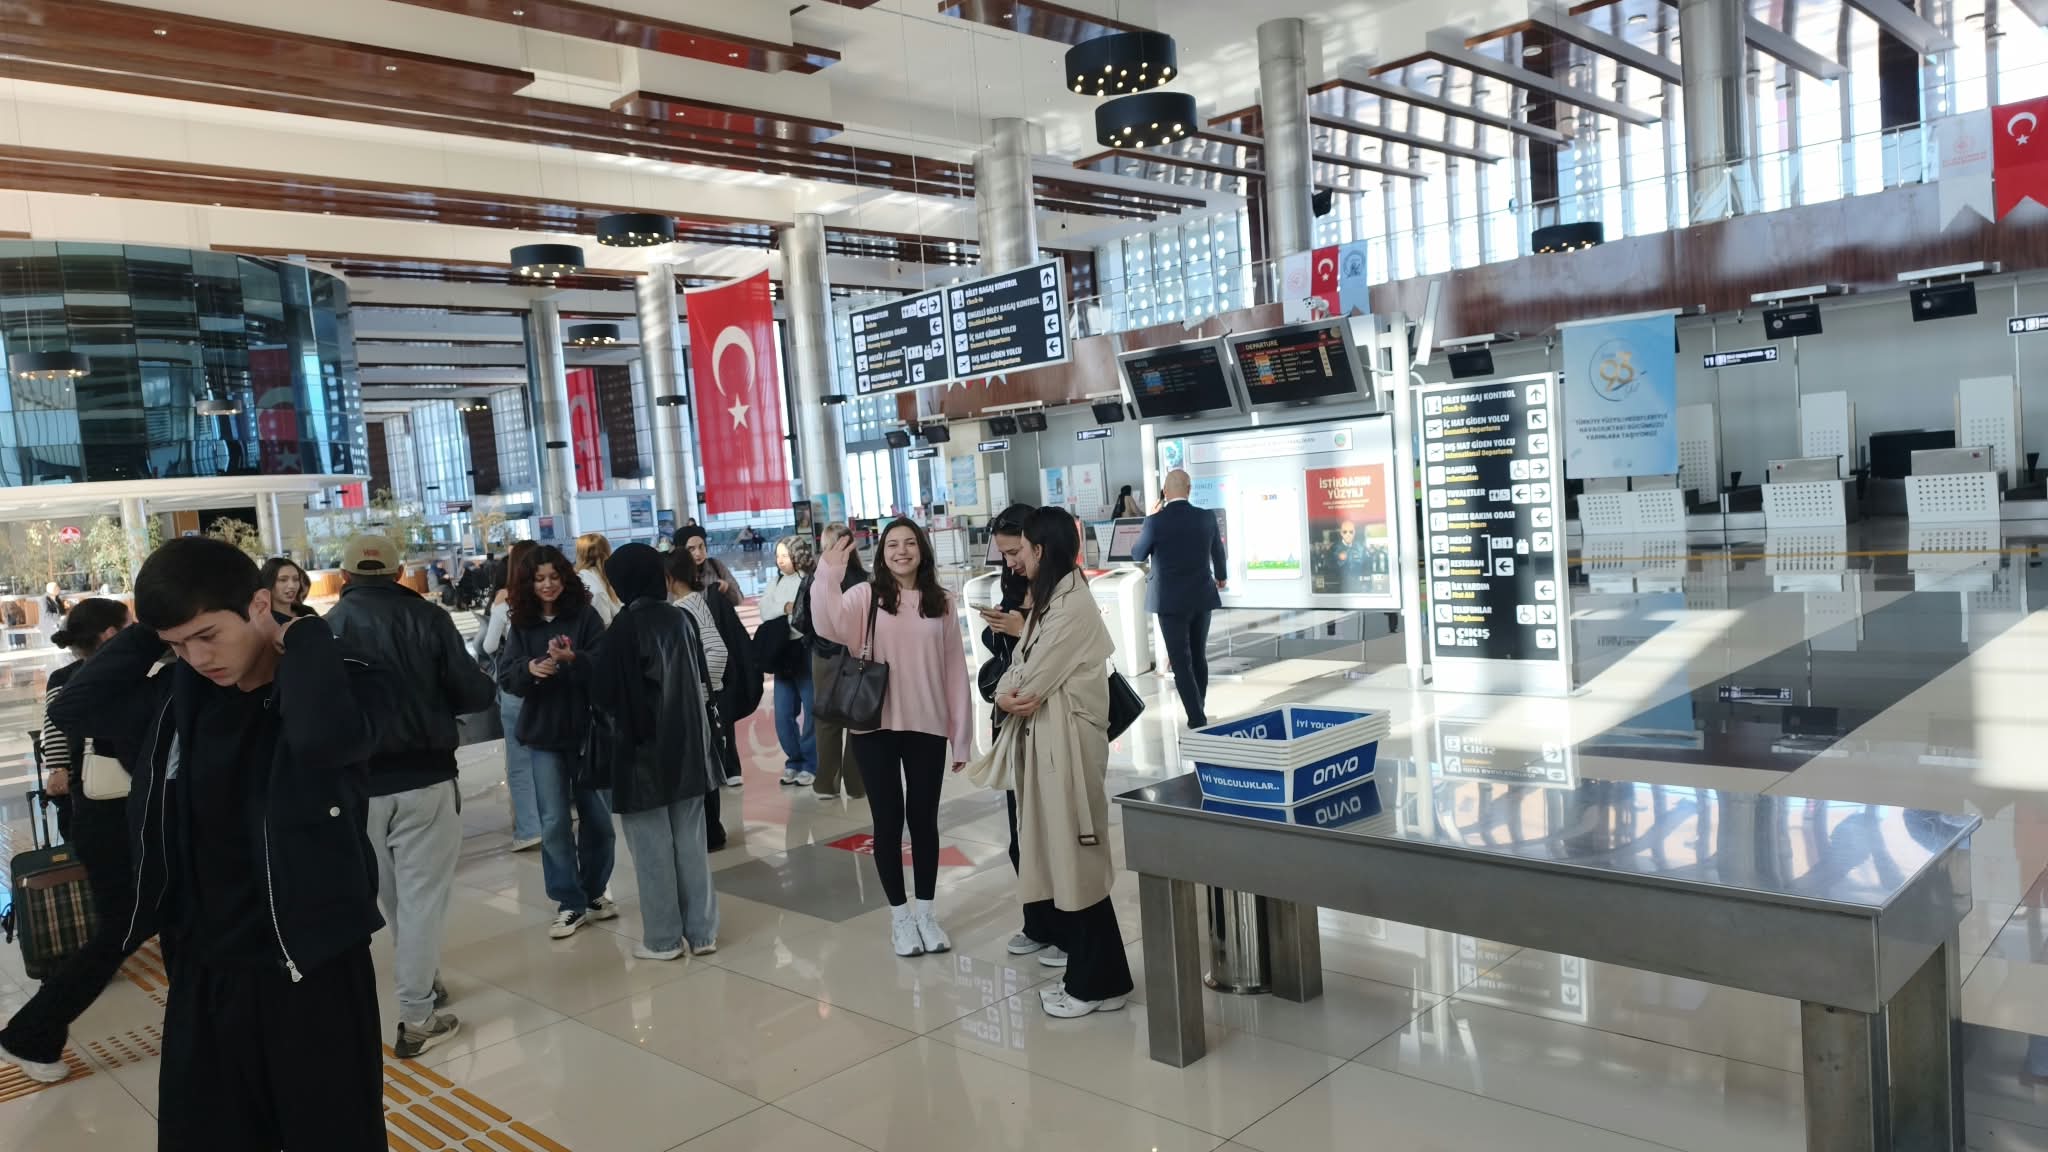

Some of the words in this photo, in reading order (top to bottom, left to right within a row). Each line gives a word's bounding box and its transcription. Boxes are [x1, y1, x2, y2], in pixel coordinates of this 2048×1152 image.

[2010, 320, 2024, 331] 13
[1245, 340, 1278, 350] DEPARTURE
[1705, 357, 1714, 366] 11
[1765, 349, 1776, 359] 12
[1461, 393, 1482, 403] BAGAJ
[1484, 390, 1515, 400] KONTROL
[1451, 418, 1464, 427] HAT
[1466, 416, 1486, 425] GİDEN
[1488, 414, 1509, 422] YOLCU
[1471, 440, 1492, 448] GİDEN
[1493, 438, 1515, 447] YOLCU
[1320, 475, 1371, 488] İSTİKRARIN
[1328, 487, 1363, 499] YÜZYILI
[1470, 512, 1492, 520] BAKIM
[1494, 511, 1515, 519] ODASI
[1456, 628, 1490, 639] ÇIKIŞ
[1457, 638, 1478, 646] Exit
[1202, 773, 1211, 783] İYİ
[1213, 777, 1280, 790] YOLCULUKLAR..
